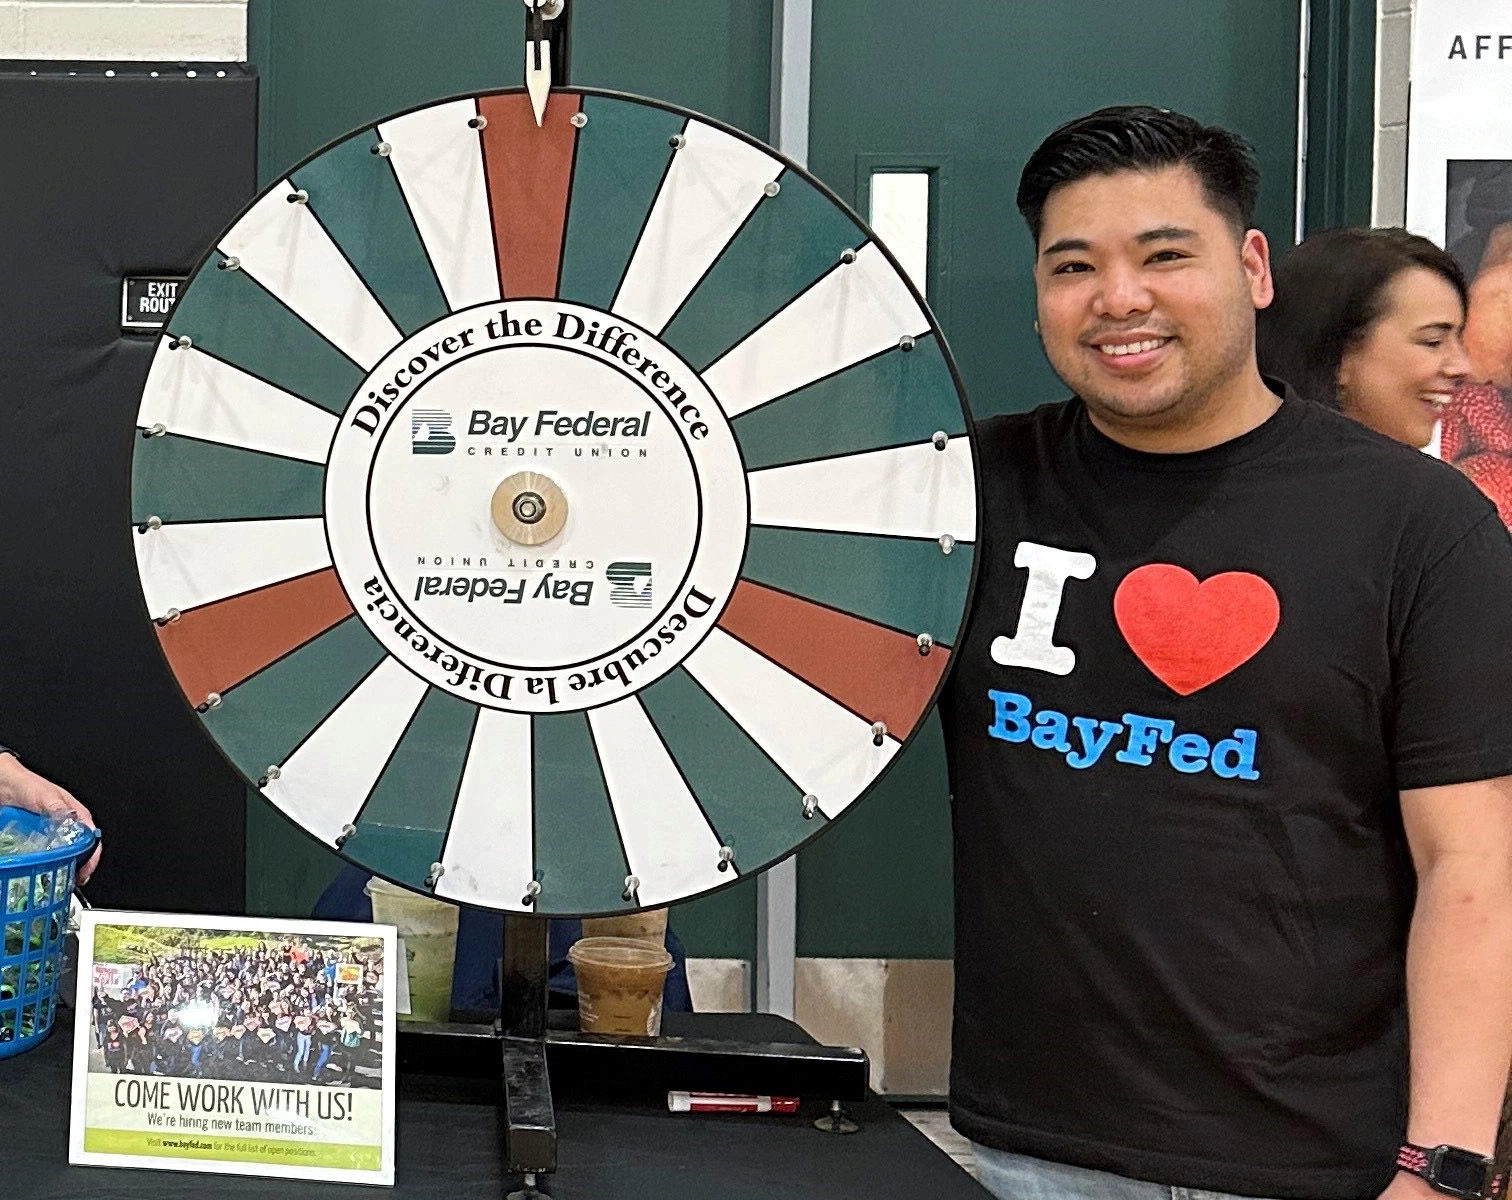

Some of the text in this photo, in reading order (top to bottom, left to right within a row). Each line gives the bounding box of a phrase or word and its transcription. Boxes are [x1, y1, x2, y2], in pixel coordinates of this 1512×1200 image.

[140, 297, 176, 313] ROUT
[148, 282, 178, 297] EXIT
[351, 309, 710, 441] Discover the Difference
[467, 410, 651, 442] Bay Federal
[467, 446, 648, 458] CREDIT UNION
[417, 555, 595, 569] CREDIT UNION
[414, 573, 594, 606] Bay Federal
[990, 541, 1097, 676] I
[363, 575, 717, 705] Descubre la Diferencia
[987, 688, 1260, 781] BayFed
[114, 1078, 353, 1121] COME WORK WITH US!
[147, 1112, 177, 1128] We're
[179, 1114, 209, 1132] hiring
[211, 1118, 233, 1131] new
[235, 1119, 262, 1133] team
